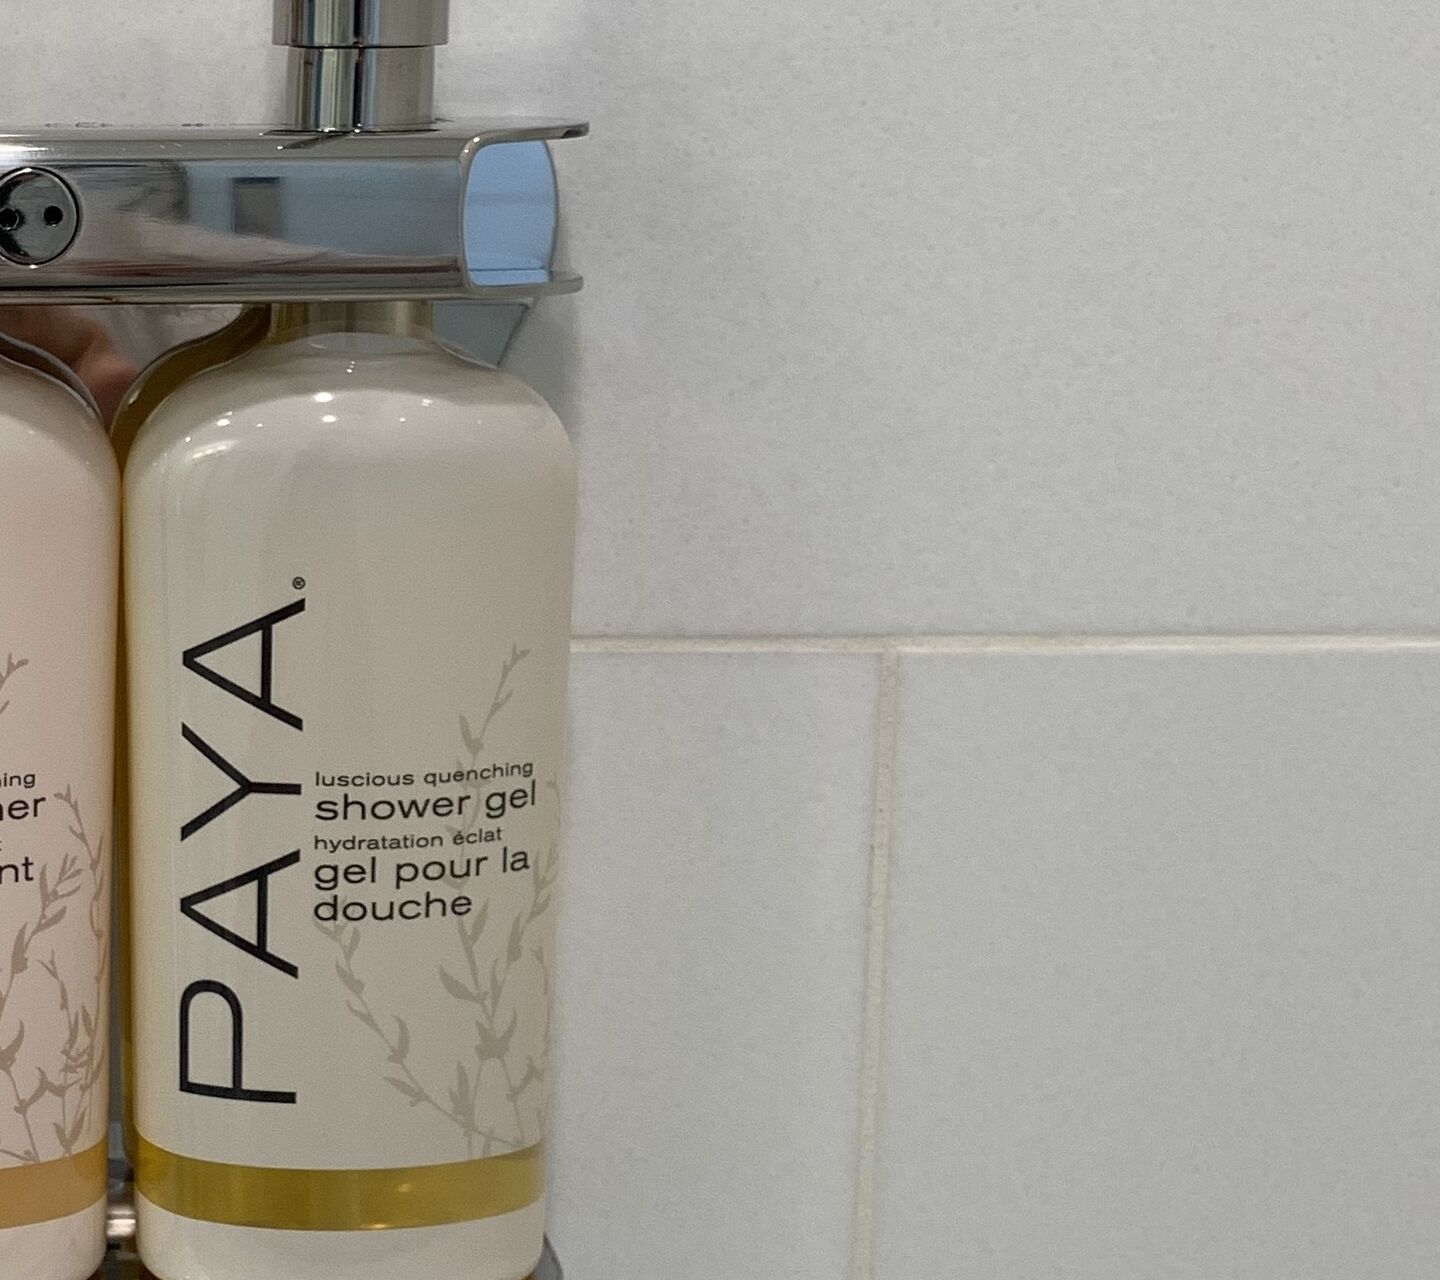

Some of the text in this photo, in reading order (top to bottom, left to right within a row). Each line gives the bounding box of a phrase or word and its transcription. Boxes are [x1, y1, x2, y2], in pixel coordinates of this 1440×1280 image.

[315, 761, 534, 788] luscious quenching
[314, 779, 537, 821] shower gel
[314, 827, 502, 854] hydratation éclat
[314, 846, 530, 891] gel pour la
[313, 893, 473, 922] douche
